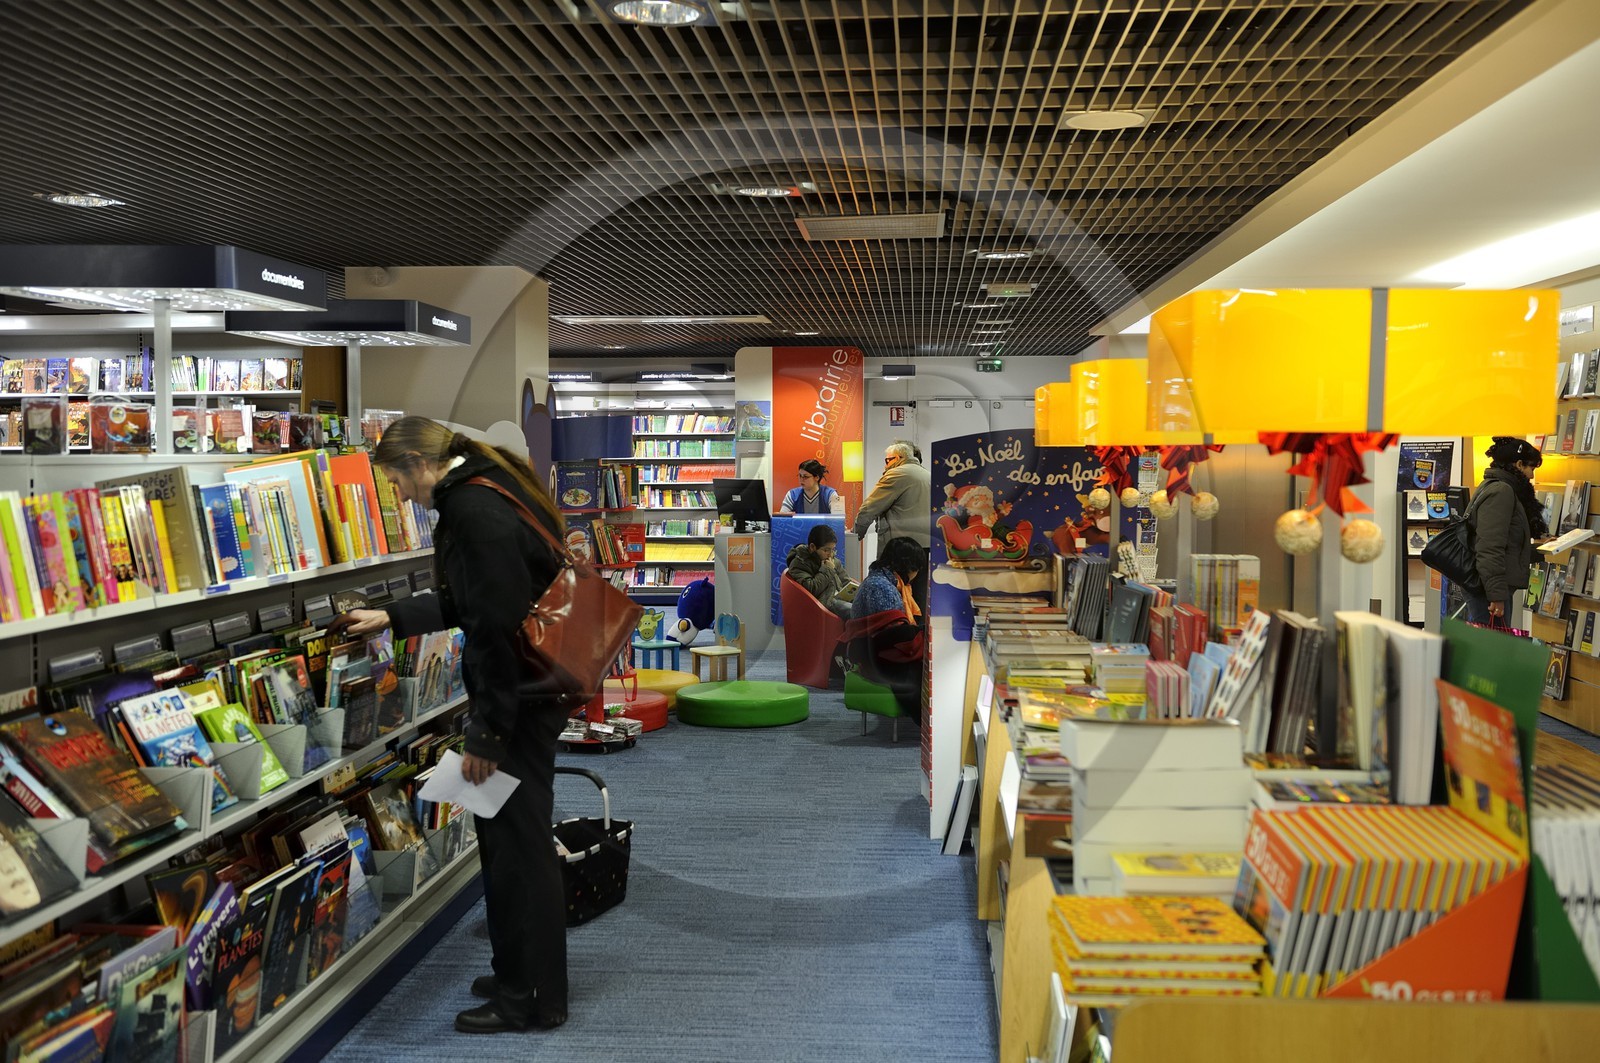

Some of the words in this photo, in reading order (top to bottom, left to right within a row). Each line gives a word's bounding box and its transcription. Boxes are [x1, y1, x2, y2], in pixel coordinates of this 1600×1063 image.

[800, 349, 849, 442] librairie
[820, 400, 843, 445] album
[838, 348, 861, 398] jeunes
[945, 453, 977, 478] Le
[978, 439, 1025, 467] Noël
[1006, 464, 1041, 486] des
[137, 724, 156, 742] LA
